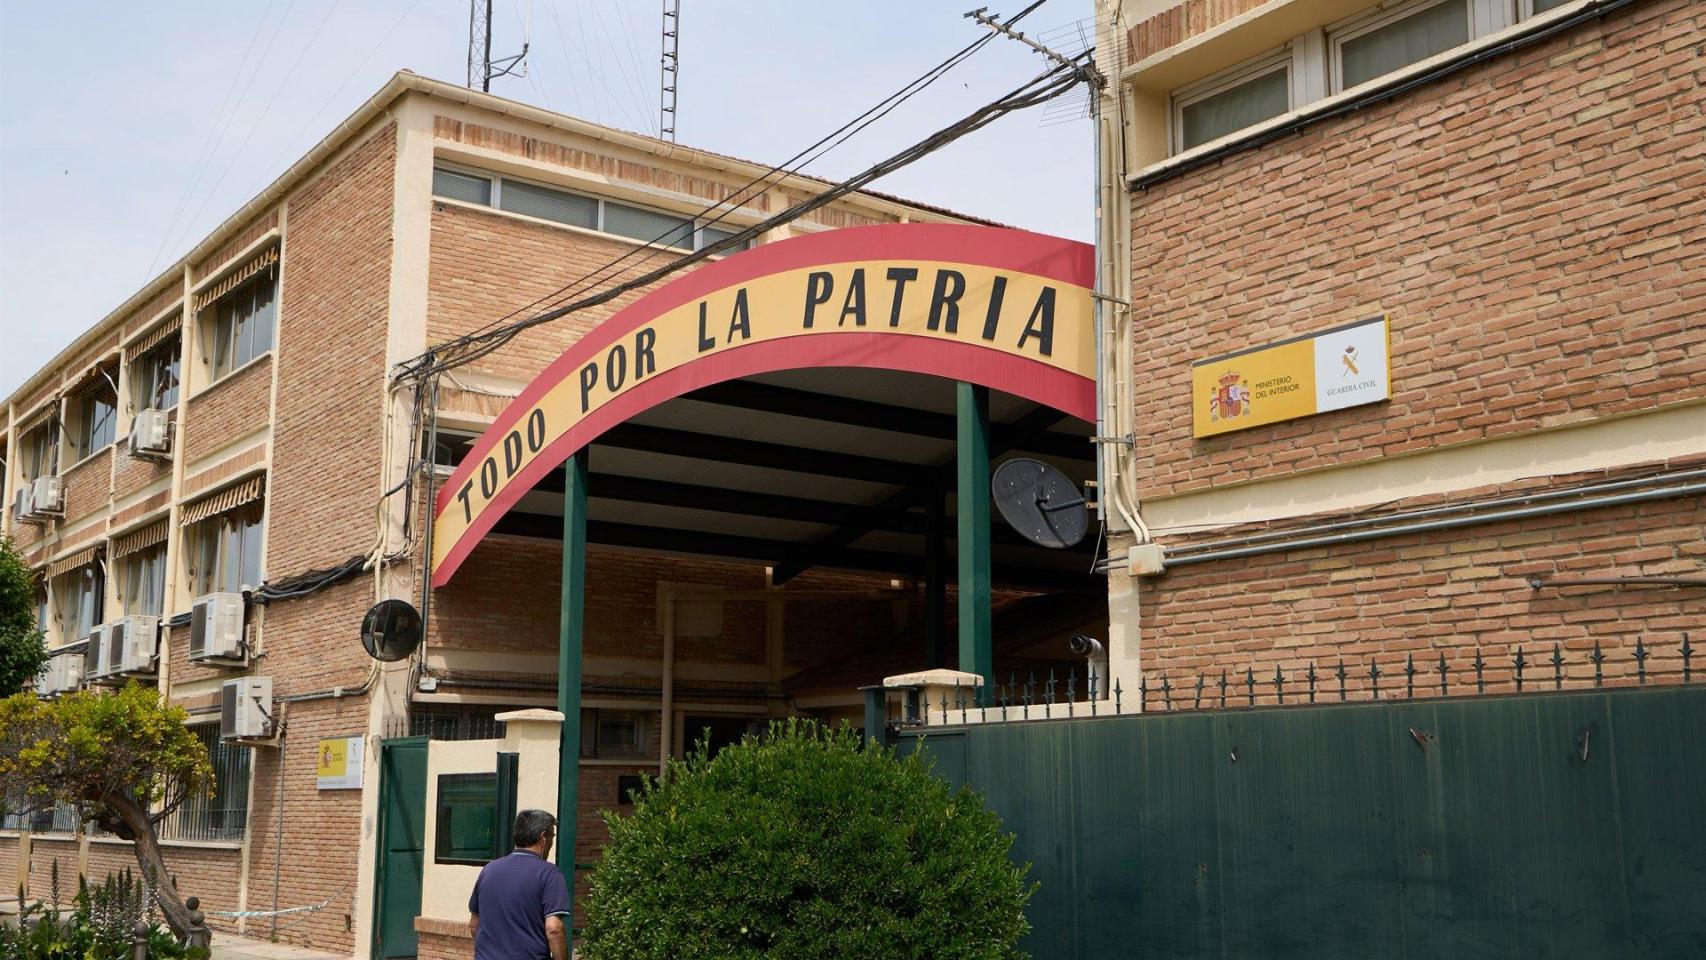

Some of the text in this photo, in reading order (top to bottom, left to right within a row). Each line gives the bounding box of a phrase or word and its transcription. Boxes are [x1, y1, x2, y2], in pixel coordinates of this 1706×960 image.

[1255, 375, 1292, 389] MINISTERIO
[1326, 380, 1376, 397] GUARDIA CIVIL
[457, 268, 1057, 525] TODO POR LA PATRIA
[1255, 383, 1300, 399] DEL INTERIOR
